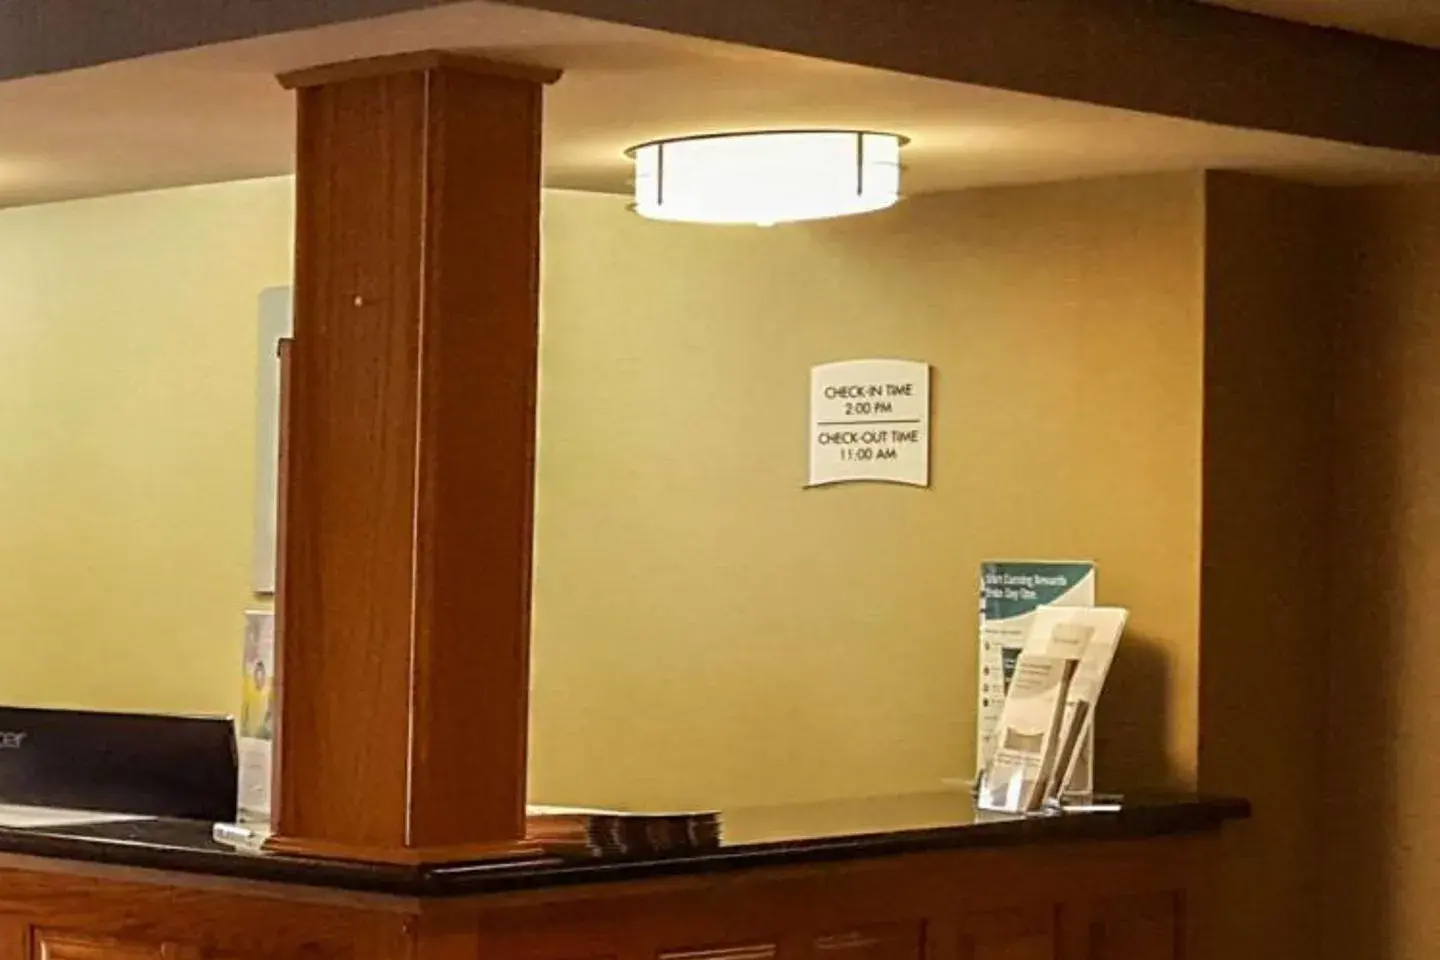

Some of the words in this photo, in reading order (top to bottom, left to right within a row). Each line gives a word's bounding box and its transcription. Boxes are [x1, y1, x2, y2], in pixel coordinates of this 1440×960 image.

[824, 385, 882, 398] CHECK-IN
[886, 384, 913, 396] TIME
[845, 402, 870, 415] 2:00
[874, 402, 892, 413] PM
[817, 431, 888, 445] CHECK-OUT
[892, 430, 918, 442] TIME
[840, 448, 873, 461] 11:00
[876, 448, 897, 460] AM
